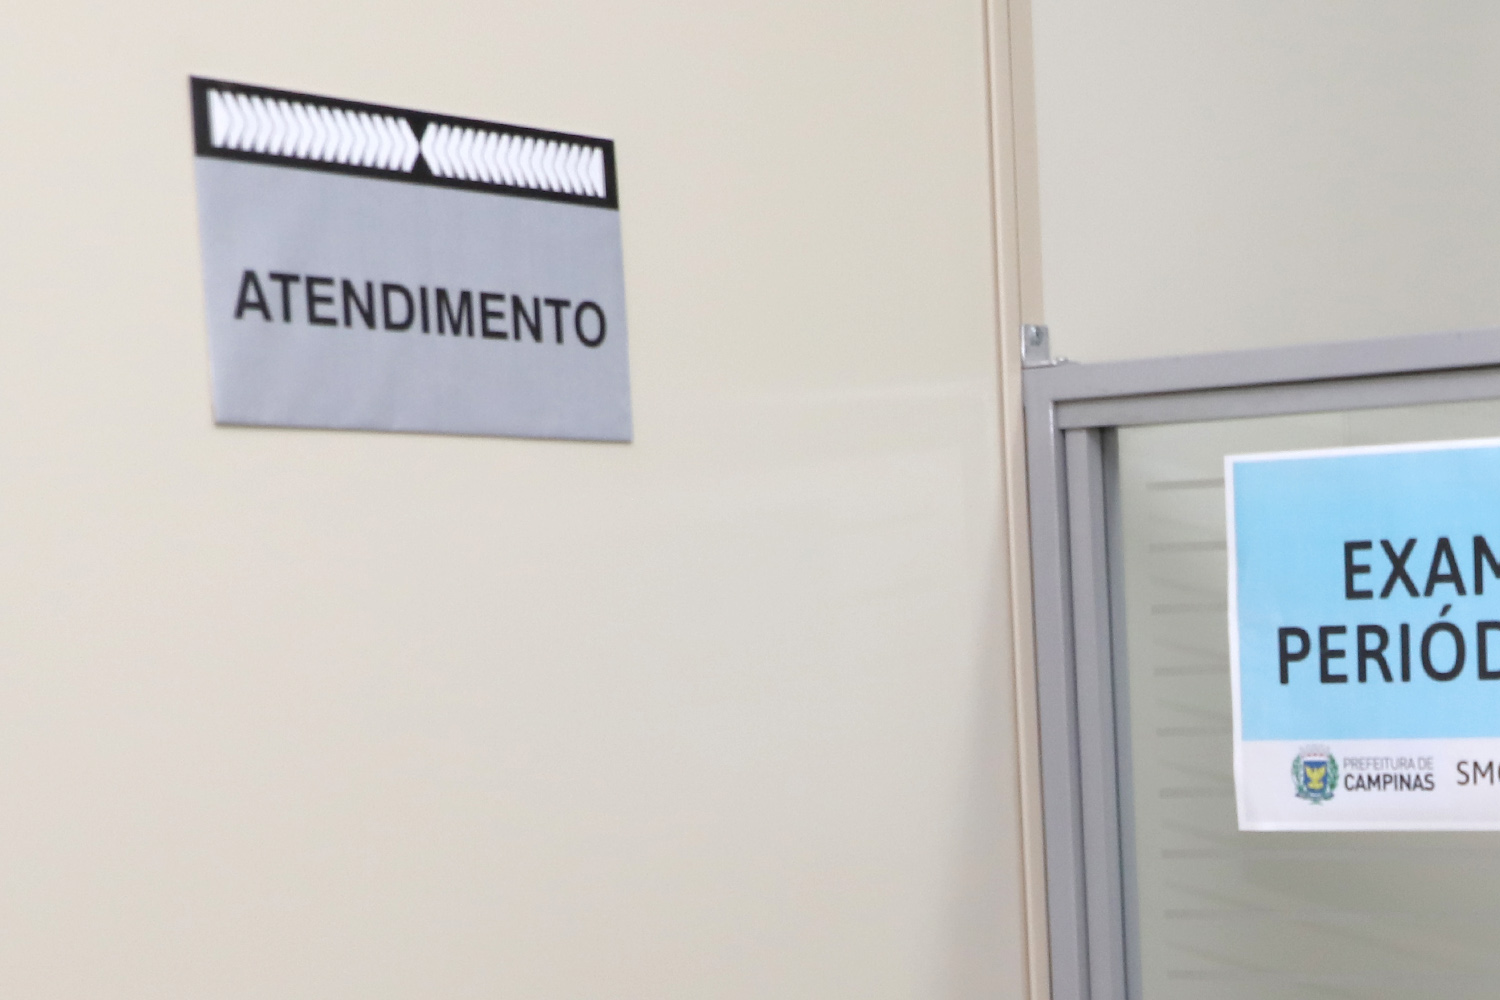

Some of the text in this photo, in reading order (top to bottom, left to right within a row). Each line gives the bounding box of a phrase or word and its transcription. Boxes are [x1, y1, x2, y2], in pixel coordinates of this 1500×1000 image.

[233, 269, 607, 349] ATENDIMENTO
[1343, 755, 1434, 771] PREFEITURA DE
[1343, 772, 1436, 792] CAMPINAS
